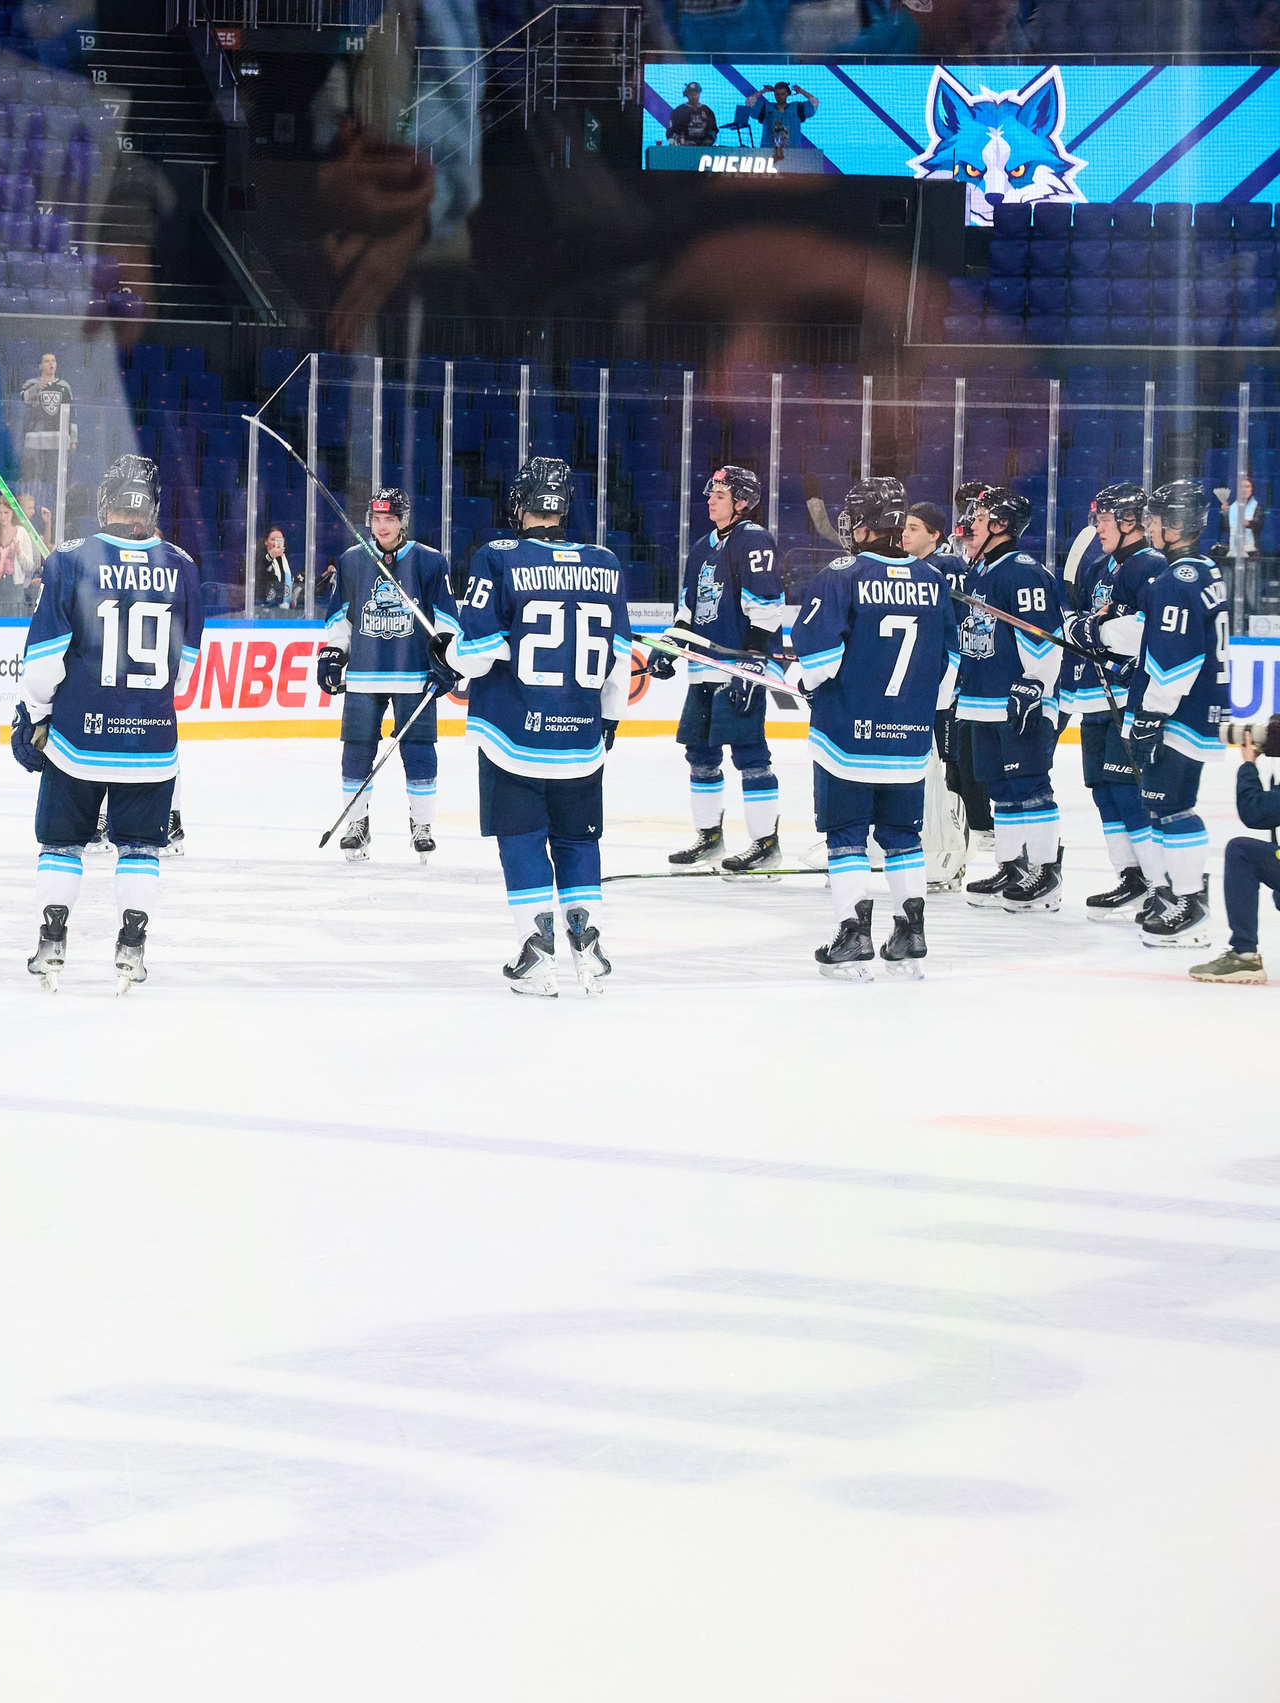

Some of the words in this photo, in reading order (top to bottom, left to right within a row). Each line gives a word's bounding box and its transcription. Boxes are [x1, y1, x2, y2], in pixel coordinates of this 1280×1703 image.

[80, 35, 95, 48] 19
[91, 69, 107, 83] 18
[117, 136, 133, 150] 16
[130, 493, 143, 507] 19
[542, 496, 559, 510] 26
[749, 550, 774, 573] 27
[99, 565, 179, 593] RYABOV
[511, 566, 620, 595] KRUTOKHVOSTOV
[858, 580, 939, 606] KOKOREV
[1017, 588, 1046, 613] 98
[1160, 605, 1189, 635] 91
[97, 600, 172, 690] 19
[518, 600, 612, 690] 26
[879, 615, 918, 697] 7
[107, 726, 147, 736] ОБЛАСТЬ
[544, 724, 580, 733] ОБЛАСТЬ
[875, 732, 908, 740] ОБЛАСТЬ
